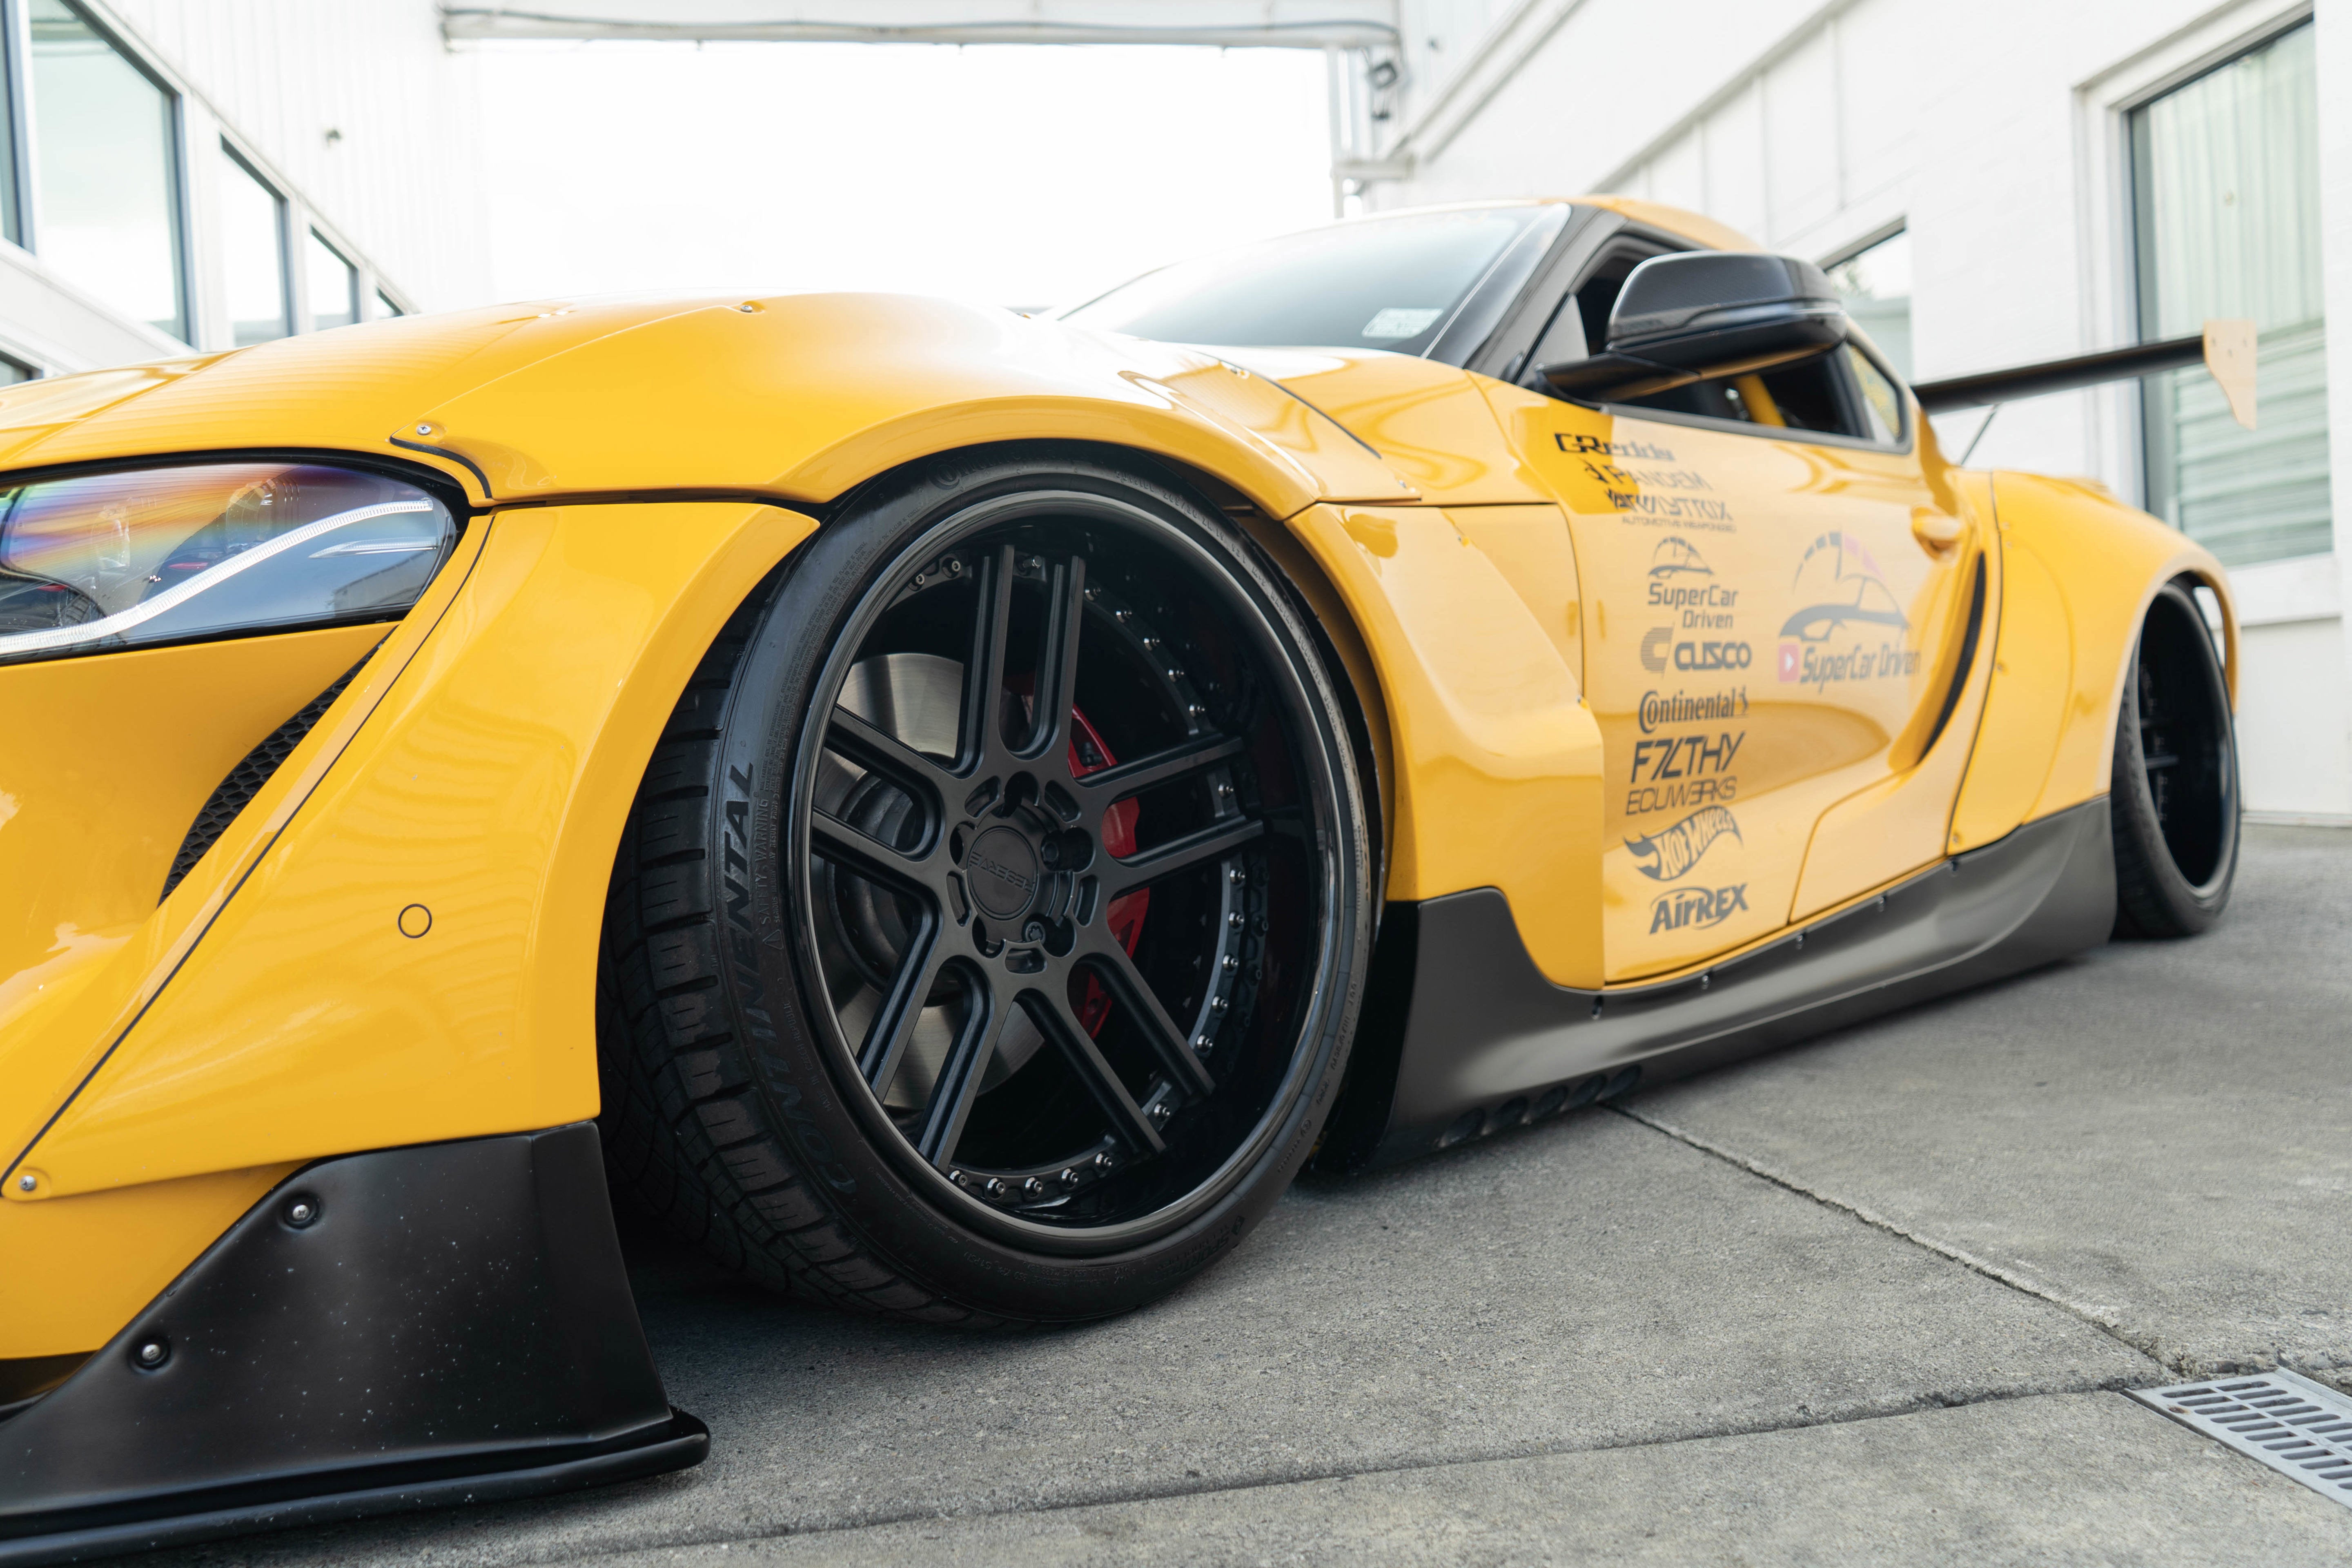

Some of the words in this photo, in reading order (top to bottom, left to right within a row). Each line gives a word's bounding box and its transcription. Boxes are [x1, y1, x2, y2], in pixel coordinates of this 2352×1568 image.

[1554, 432, 1676, 461] GReddy
[1648, 582, 1739, 610] SuperCar
[1682, 608, 1733, 630] Driven
[1800, 641, 1877, 694] SuperCar
[1878, 643, 1921, 679] Driven
[1638, 686, 1736, 734] Continental
[754, 799, 769, 862] WARNING
[969, 851, 1036, 895] RESERVE
[755, 873, 771, 926] SAFETY
[724, 762, 858, 1195] CONTINENTAL
[796, 1042, 814, 1074] CZECH
[809, 1073, 820, 1088] IN
[815, 1086, 834, 1114] MADE
